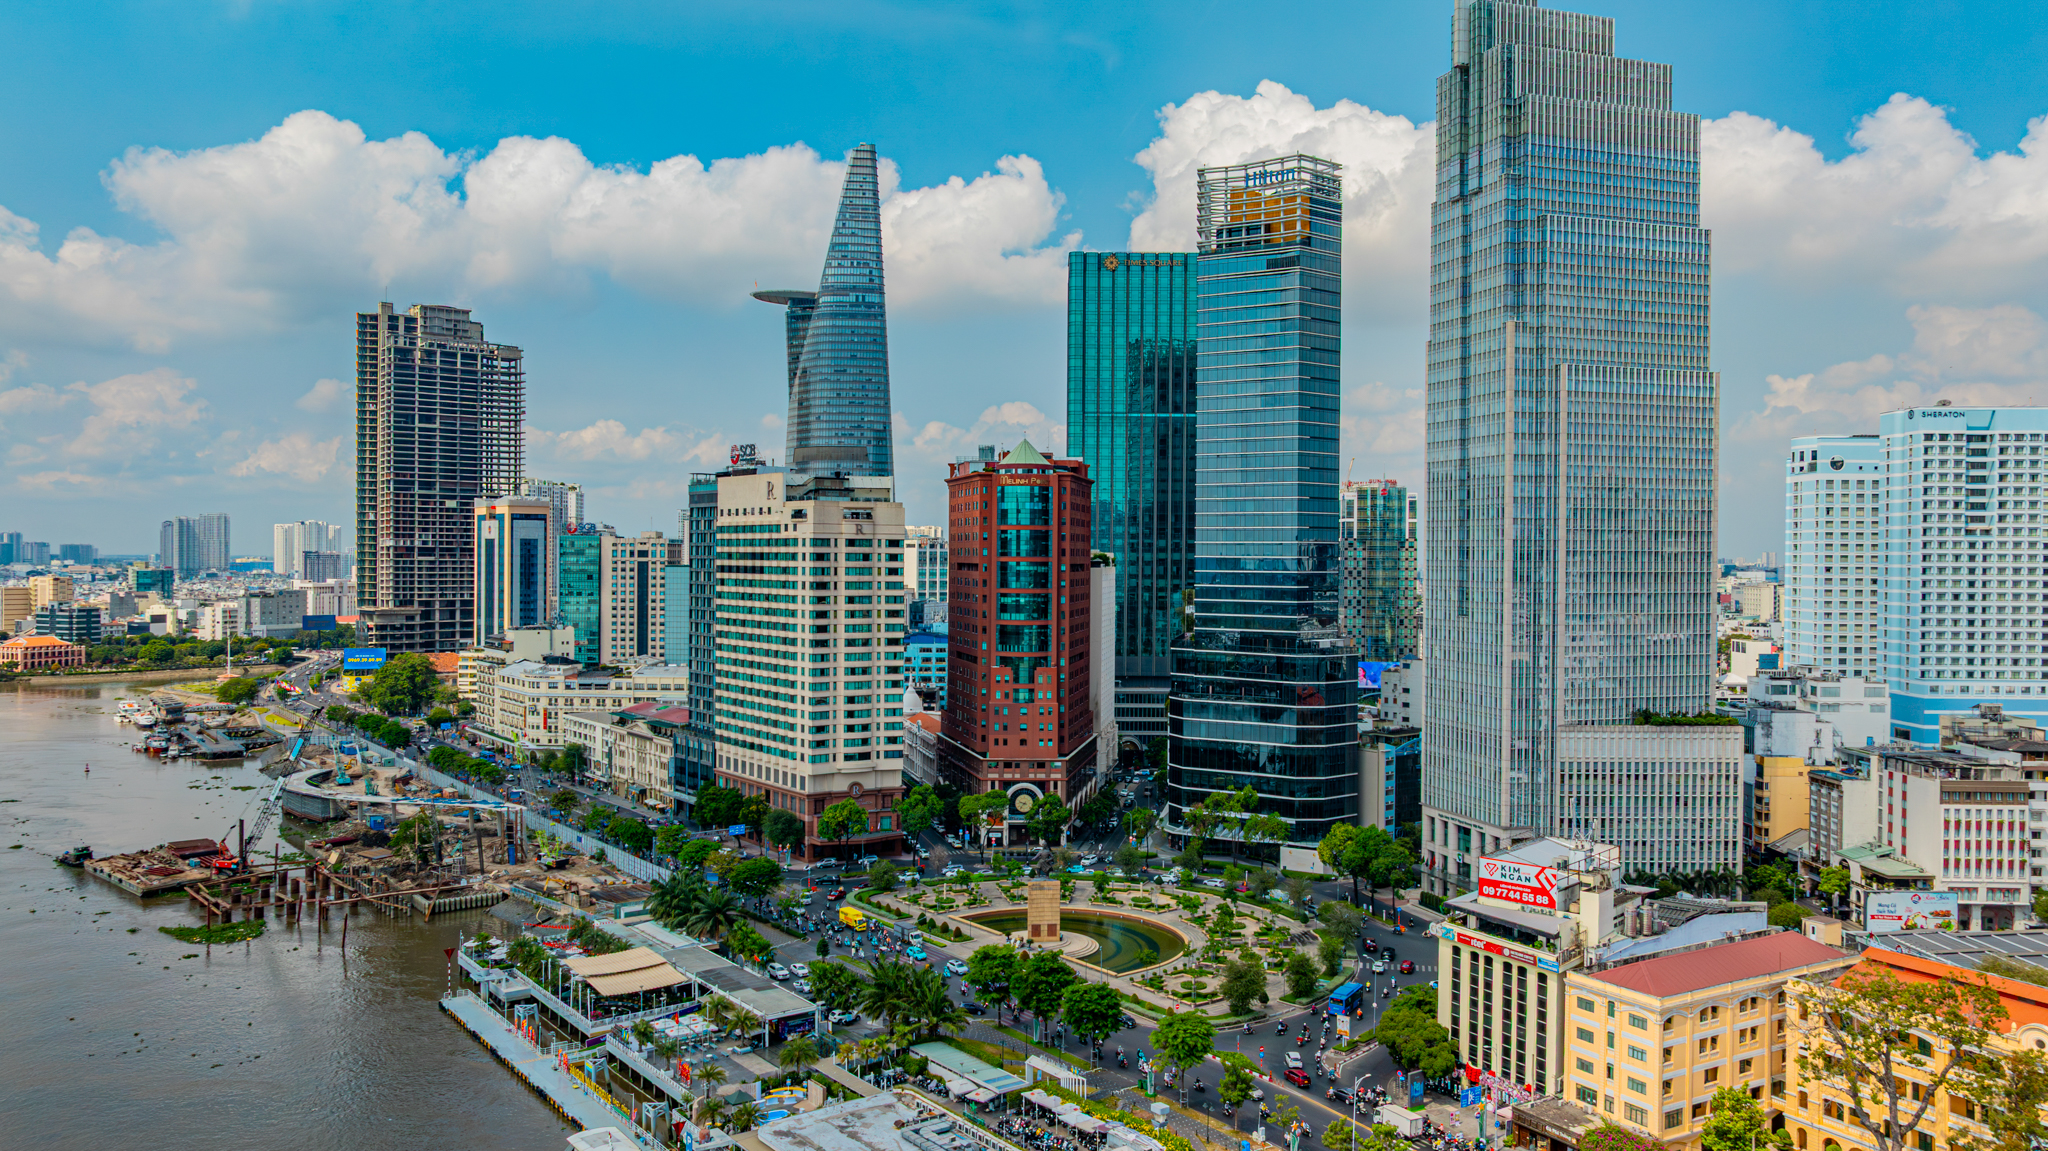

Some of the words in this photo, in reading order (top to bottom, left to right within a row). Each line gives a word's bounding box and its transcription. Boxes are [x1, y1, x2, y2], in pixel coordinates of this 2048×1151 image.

[1245, 168, 1296, 188] Hilton
[1124, 259, 1148, 267] TIMES
[1149, 259, 1183, 267] SQUARE
[739, 443, 756, 458] SCB
[578, 522, 597, 531] SCB
[852, 785, 861, 795] R
[1500, 864, 1521, 874] KIM
[1500, 871, 1532, 884] NGAN
